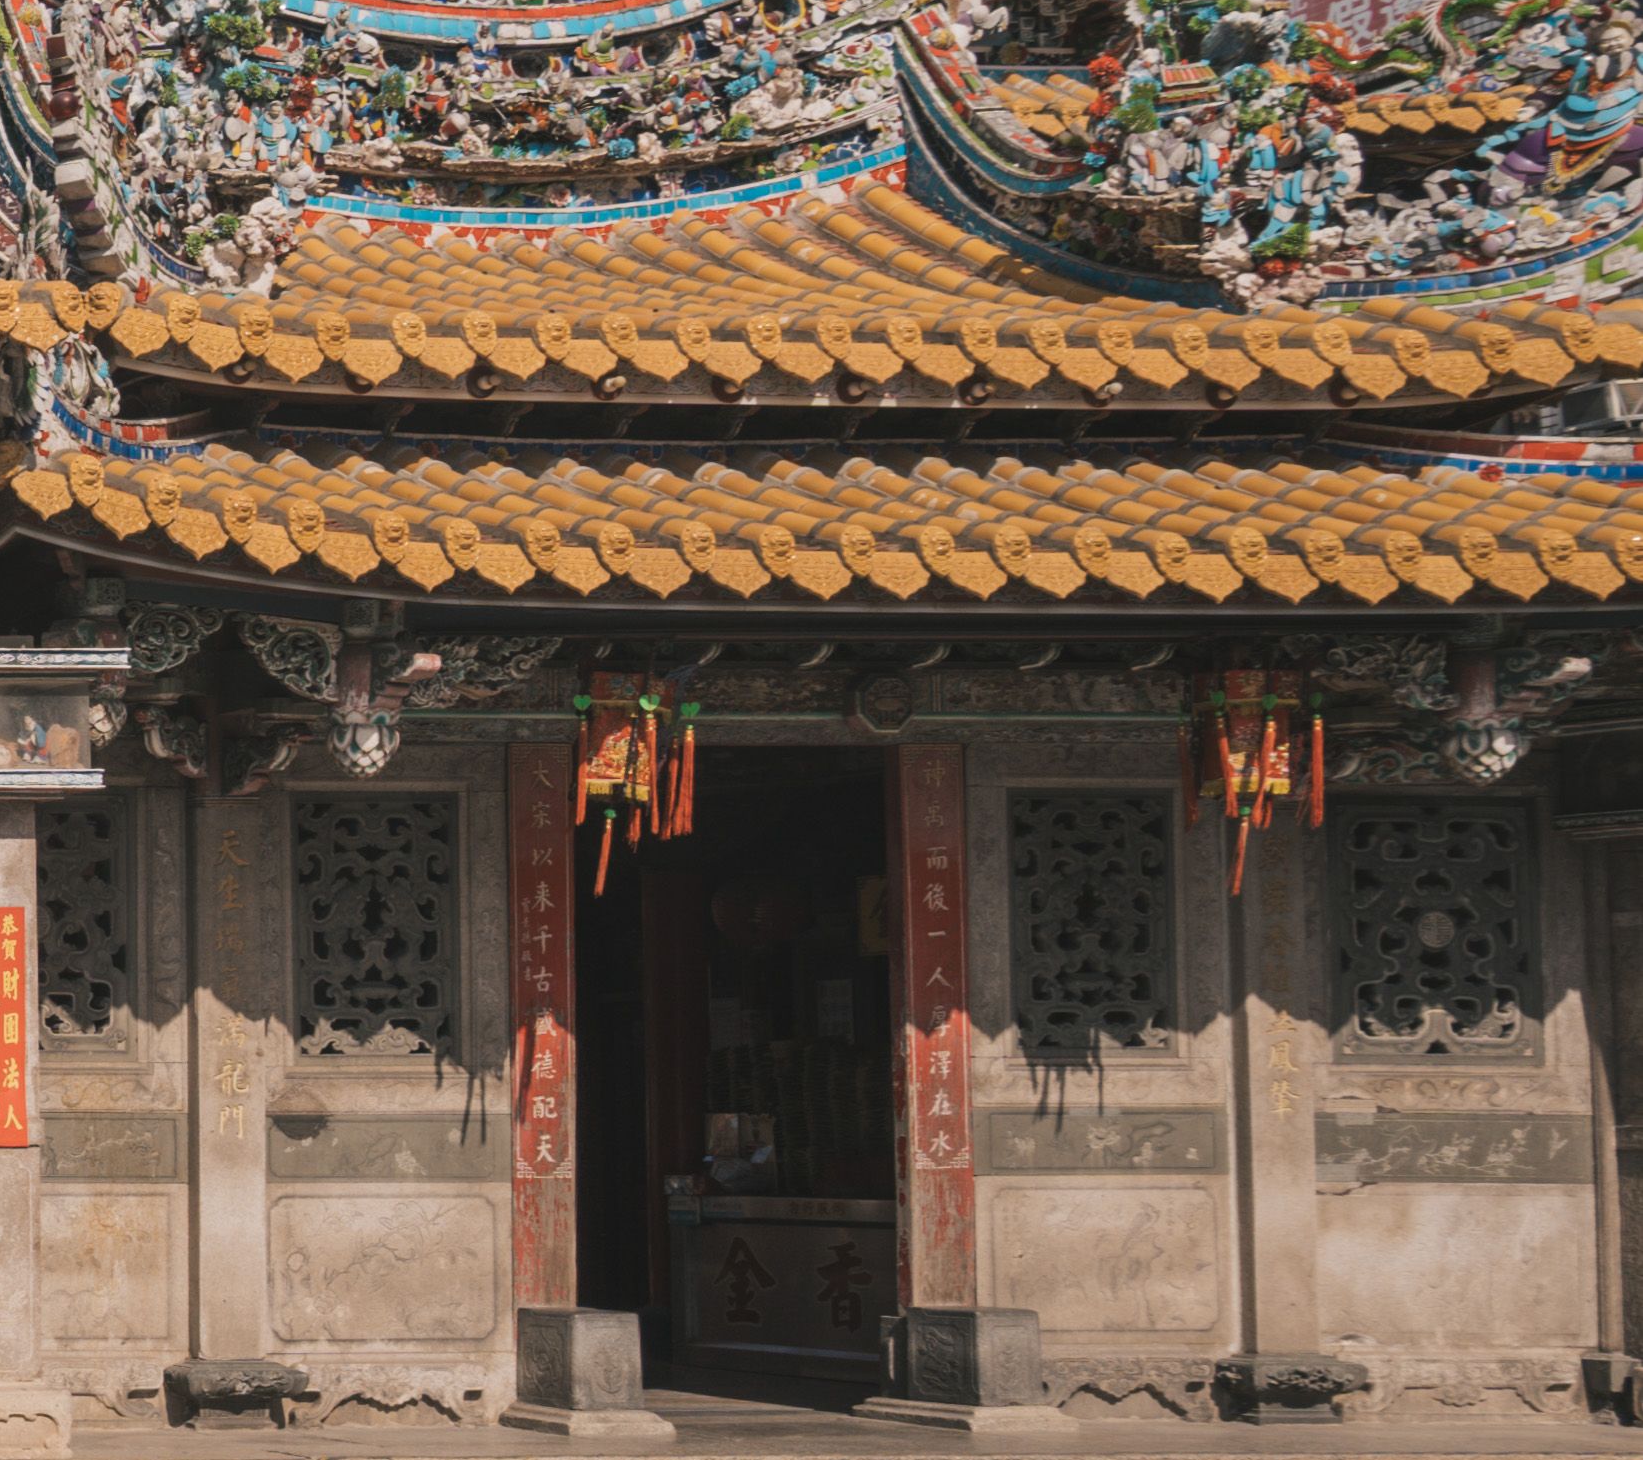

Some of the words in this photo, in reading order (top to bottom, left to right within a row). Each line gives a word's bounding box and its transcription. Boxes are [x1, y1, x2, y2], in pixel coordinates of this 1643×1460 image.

[1, 913, 23, 1131] 恭賀財團法人
